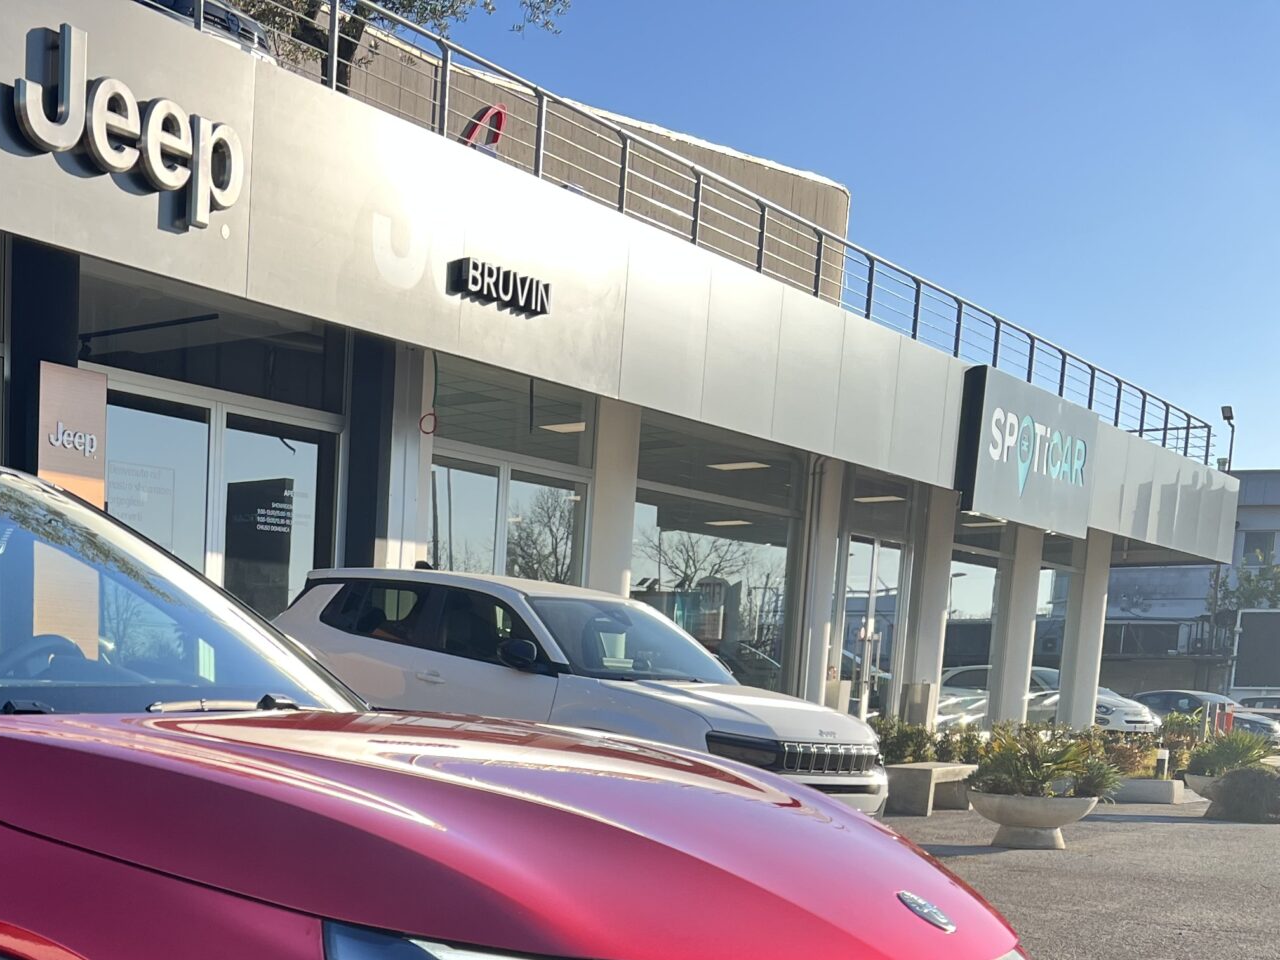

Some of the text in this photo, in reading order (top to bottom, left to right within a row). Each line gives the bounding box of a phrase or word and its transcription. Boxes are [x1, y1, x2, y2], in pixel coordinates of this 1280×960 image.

[14, 23, 244, 229] Jeep
[468, 257, 552, 314] BRUVIN
[48, 420, 97, 457] Jeep
